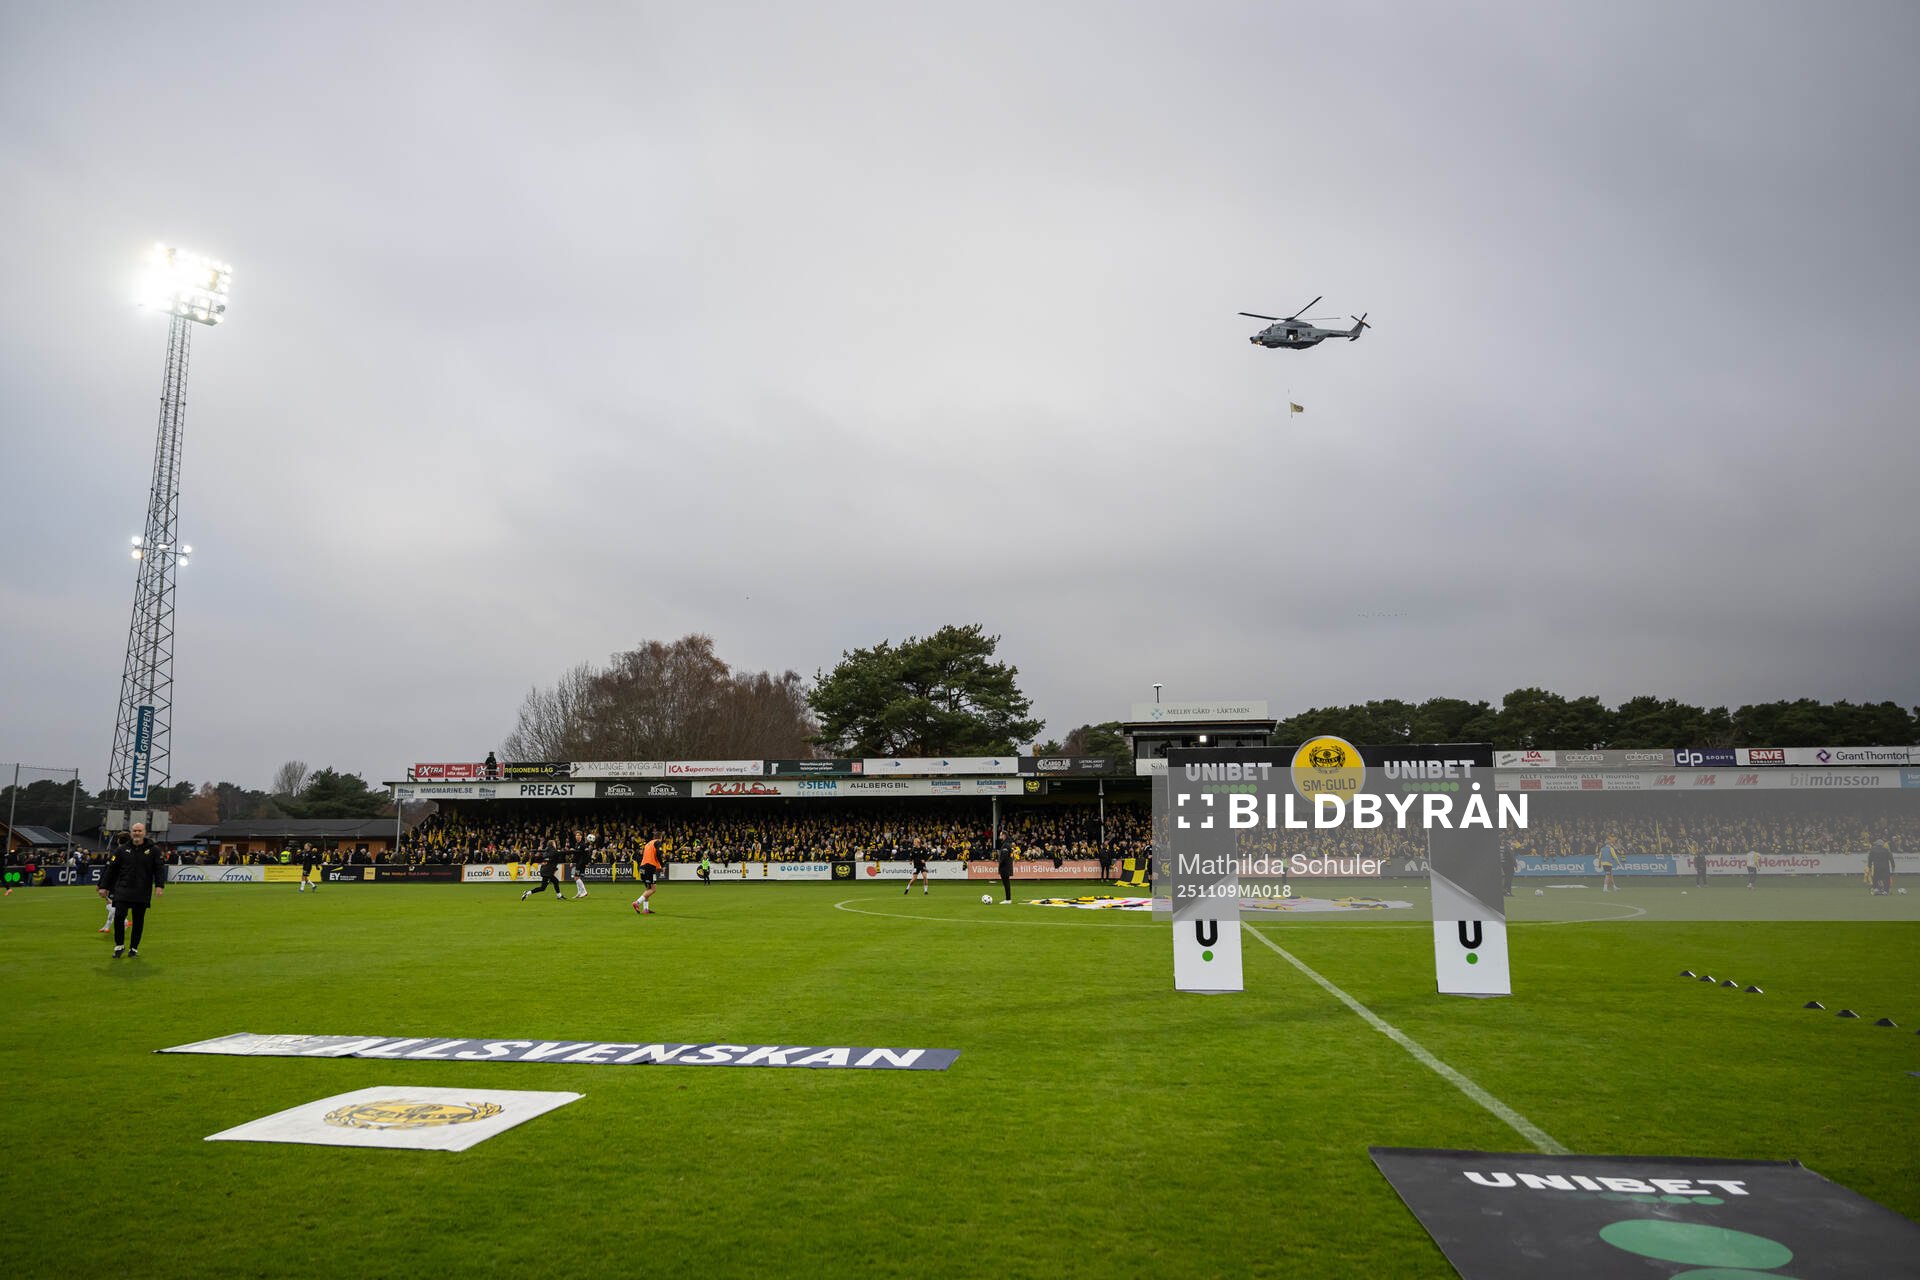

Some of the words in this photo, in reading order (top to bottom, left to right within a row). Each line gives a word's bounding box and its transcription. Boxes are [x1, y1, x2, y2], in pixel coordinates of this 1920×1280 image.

[1565, 751, 1604, 761] colorama
[1625, 751, 1664, 760] colorama
[1676, 748, 1703, 767] dp
[1751, 750, 1783, 760] SAVE
[668, 765, 683, 773] ICA
[684, 765, 725, 773] Supermarket
[1185, 762, 1273, 782] UNIBET
[1384, 759, 1475, 780] UNIBET
[806, 780, 837, 789] STENA
[1303, 778, 1356, 792] SM-GULD
[1790, 772, 1880, 786] bilmånsson
[520, 784, 576, 796] PREFAST
[1526, 863, 1585, 871] LARSSON
[1687, 856, 1747, 868] Hmköp
[1758, 855, 1820, 868] Hemköp
[584, 867, 632, 875] BILCENRUM
[1021, 865, 1031, 873] till
[59, 867, 77, 885] dp
[329, 872, 341, 880] EY
[1195, 918, 1219, 947] U
[1458, 920, 1483, 949] U
[312, 1037, 927, 1068] ALLSVENSKAN
[1463, 1171, 1750, 1196] UNIBET
